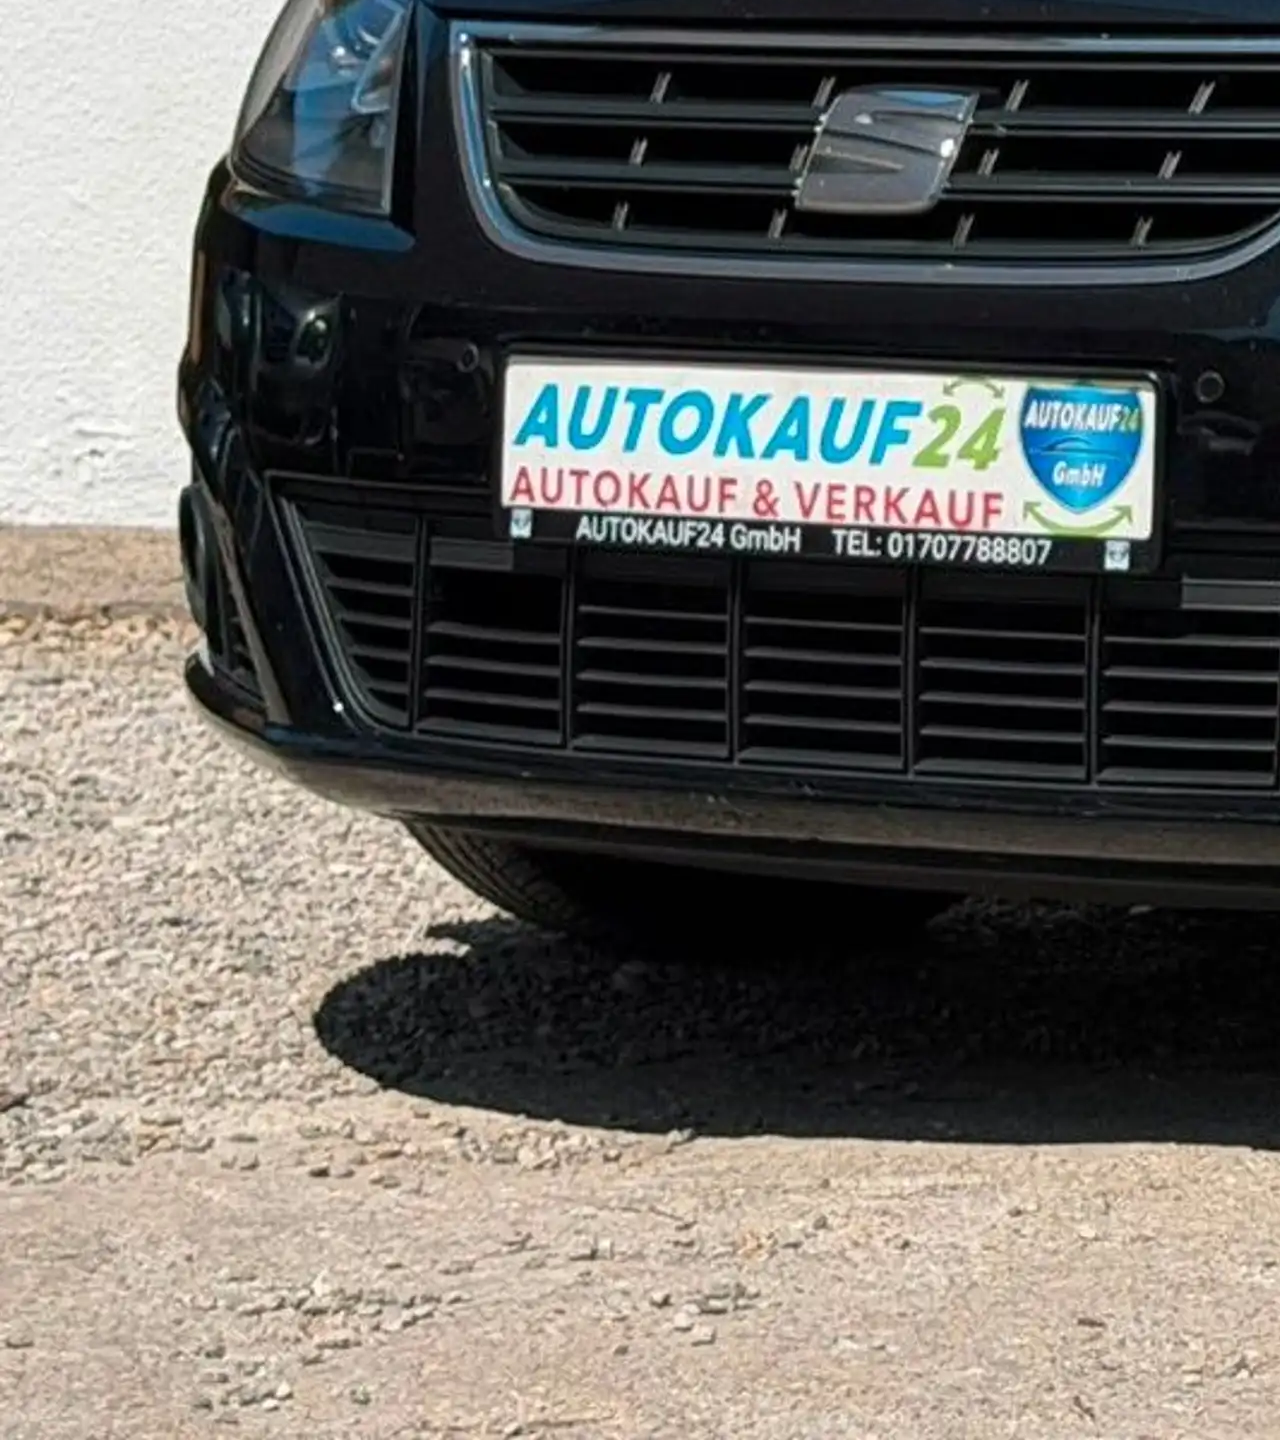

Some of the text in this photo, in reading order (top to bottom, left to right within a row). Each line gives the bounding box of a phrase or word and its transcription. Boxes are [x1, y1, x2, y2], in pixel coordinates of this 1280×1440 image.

[513, 383, 1006, 471] AUTOKAUF24
[1024, 399, 1140, 432] AUTOKAUF24
[510, 465, 1004, 529] AUTOKAUF & VERKAUF
[1052, 460, 1106, 487] GmbH
[575, 515, 1053, 566] AUTOKAUF24 GmbH TEL: 01707788807
